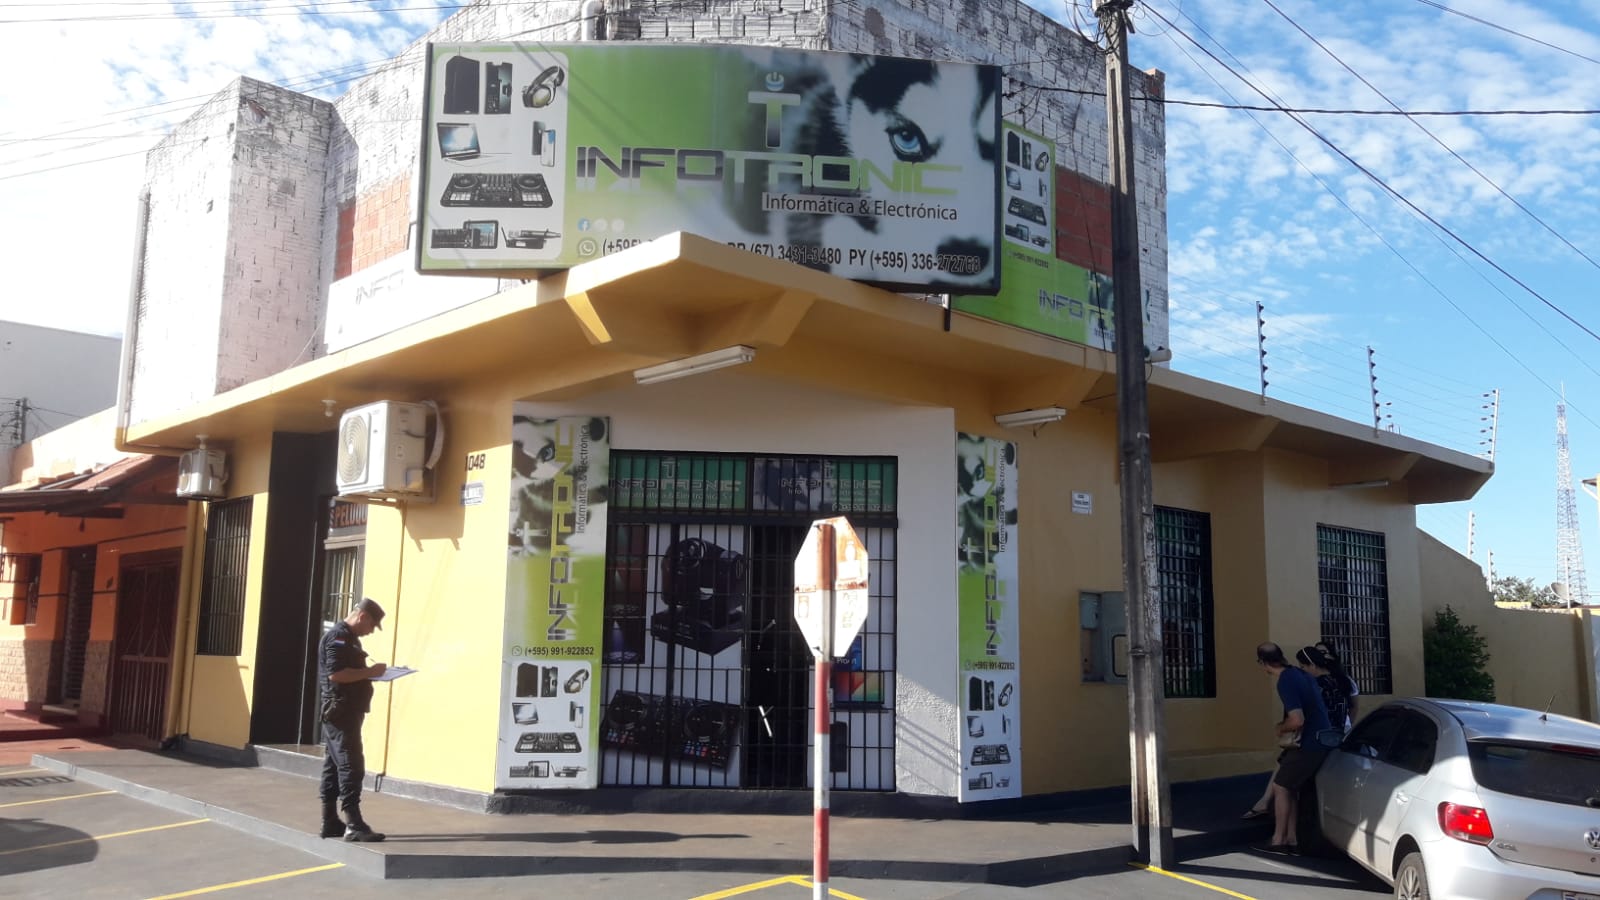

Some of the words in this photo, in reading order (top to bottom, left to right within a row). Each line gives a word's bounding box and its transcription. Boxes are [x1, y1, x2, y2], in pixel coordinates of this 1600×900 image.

[576, 146, 962, 196] INFOTRONIC
[765, 193, 854, 214] Informática
[858, 200, 872, 215] &
[874, 200, 958, 221] Electrónica
[849, 249, 867, 267] PY
[870, 250, 909, 273] (+595)
[465, 453, 486, 471] 1048
